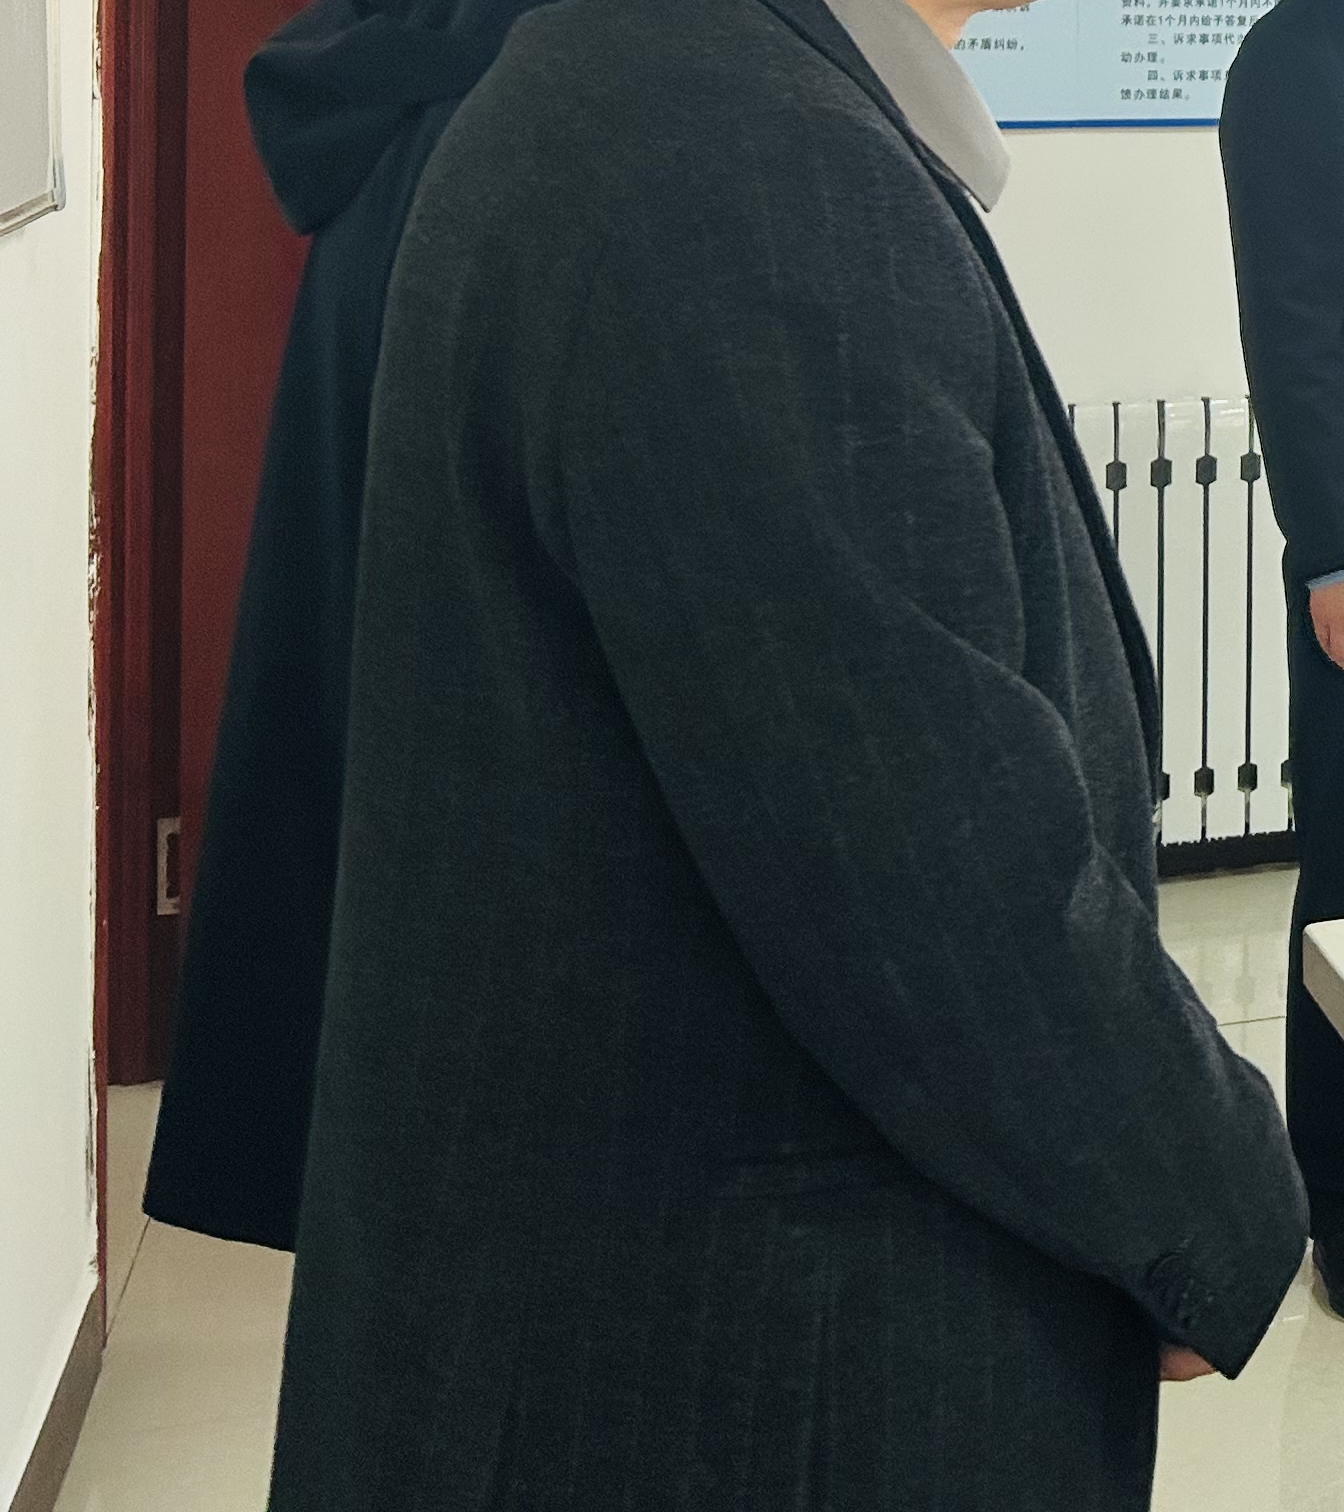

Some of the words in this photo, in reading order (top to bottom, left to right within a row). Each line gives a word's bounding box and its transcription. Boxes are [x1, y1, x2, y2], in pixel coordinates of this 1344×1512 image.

[1121, 52, 1165, 64] 动办理。
[1148, 69, 1229, 82] 四、诉求事项
